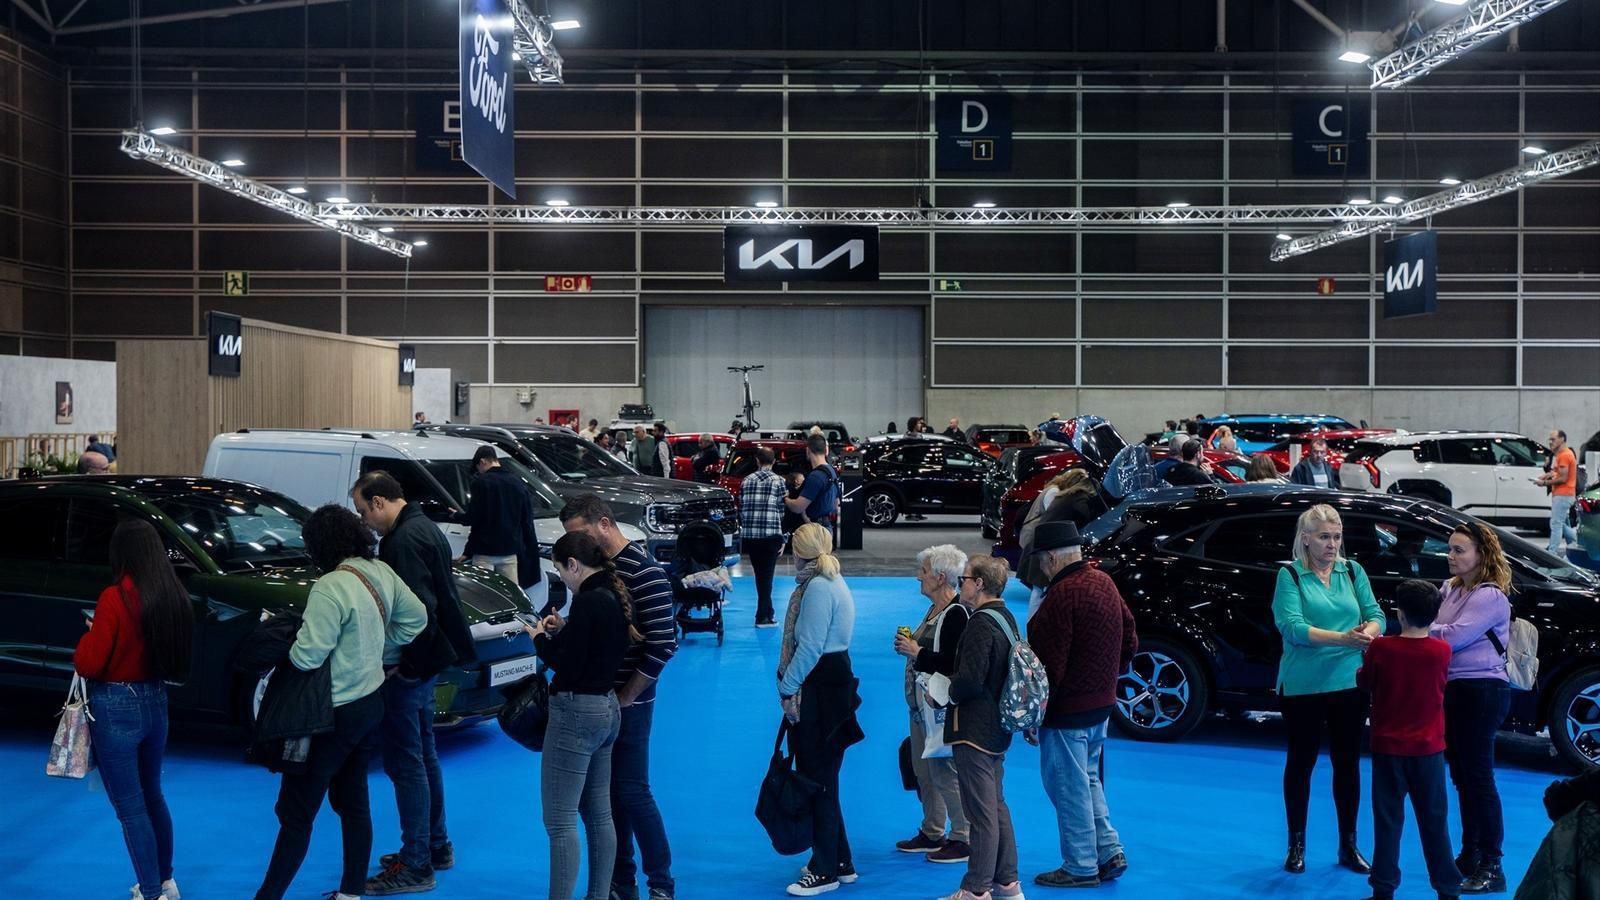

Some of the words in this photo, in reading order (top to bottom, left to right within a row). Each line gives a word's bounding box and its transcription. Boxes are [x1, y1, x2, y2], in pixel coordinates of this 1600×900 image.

[469, 14, 507, 134] Ford
[443, 100, 461, 133] E
[961, 100, 989, 133] D
[1318, 104, 1343, 137] C
[979, 143, 986, 157] 1
[1335, 147, 1341, 161] 1
[738, 238, 864, 270] KIA
[1386, 258, 1424, 293] KIA
[494, 667, 515, 679] MUSTANG
